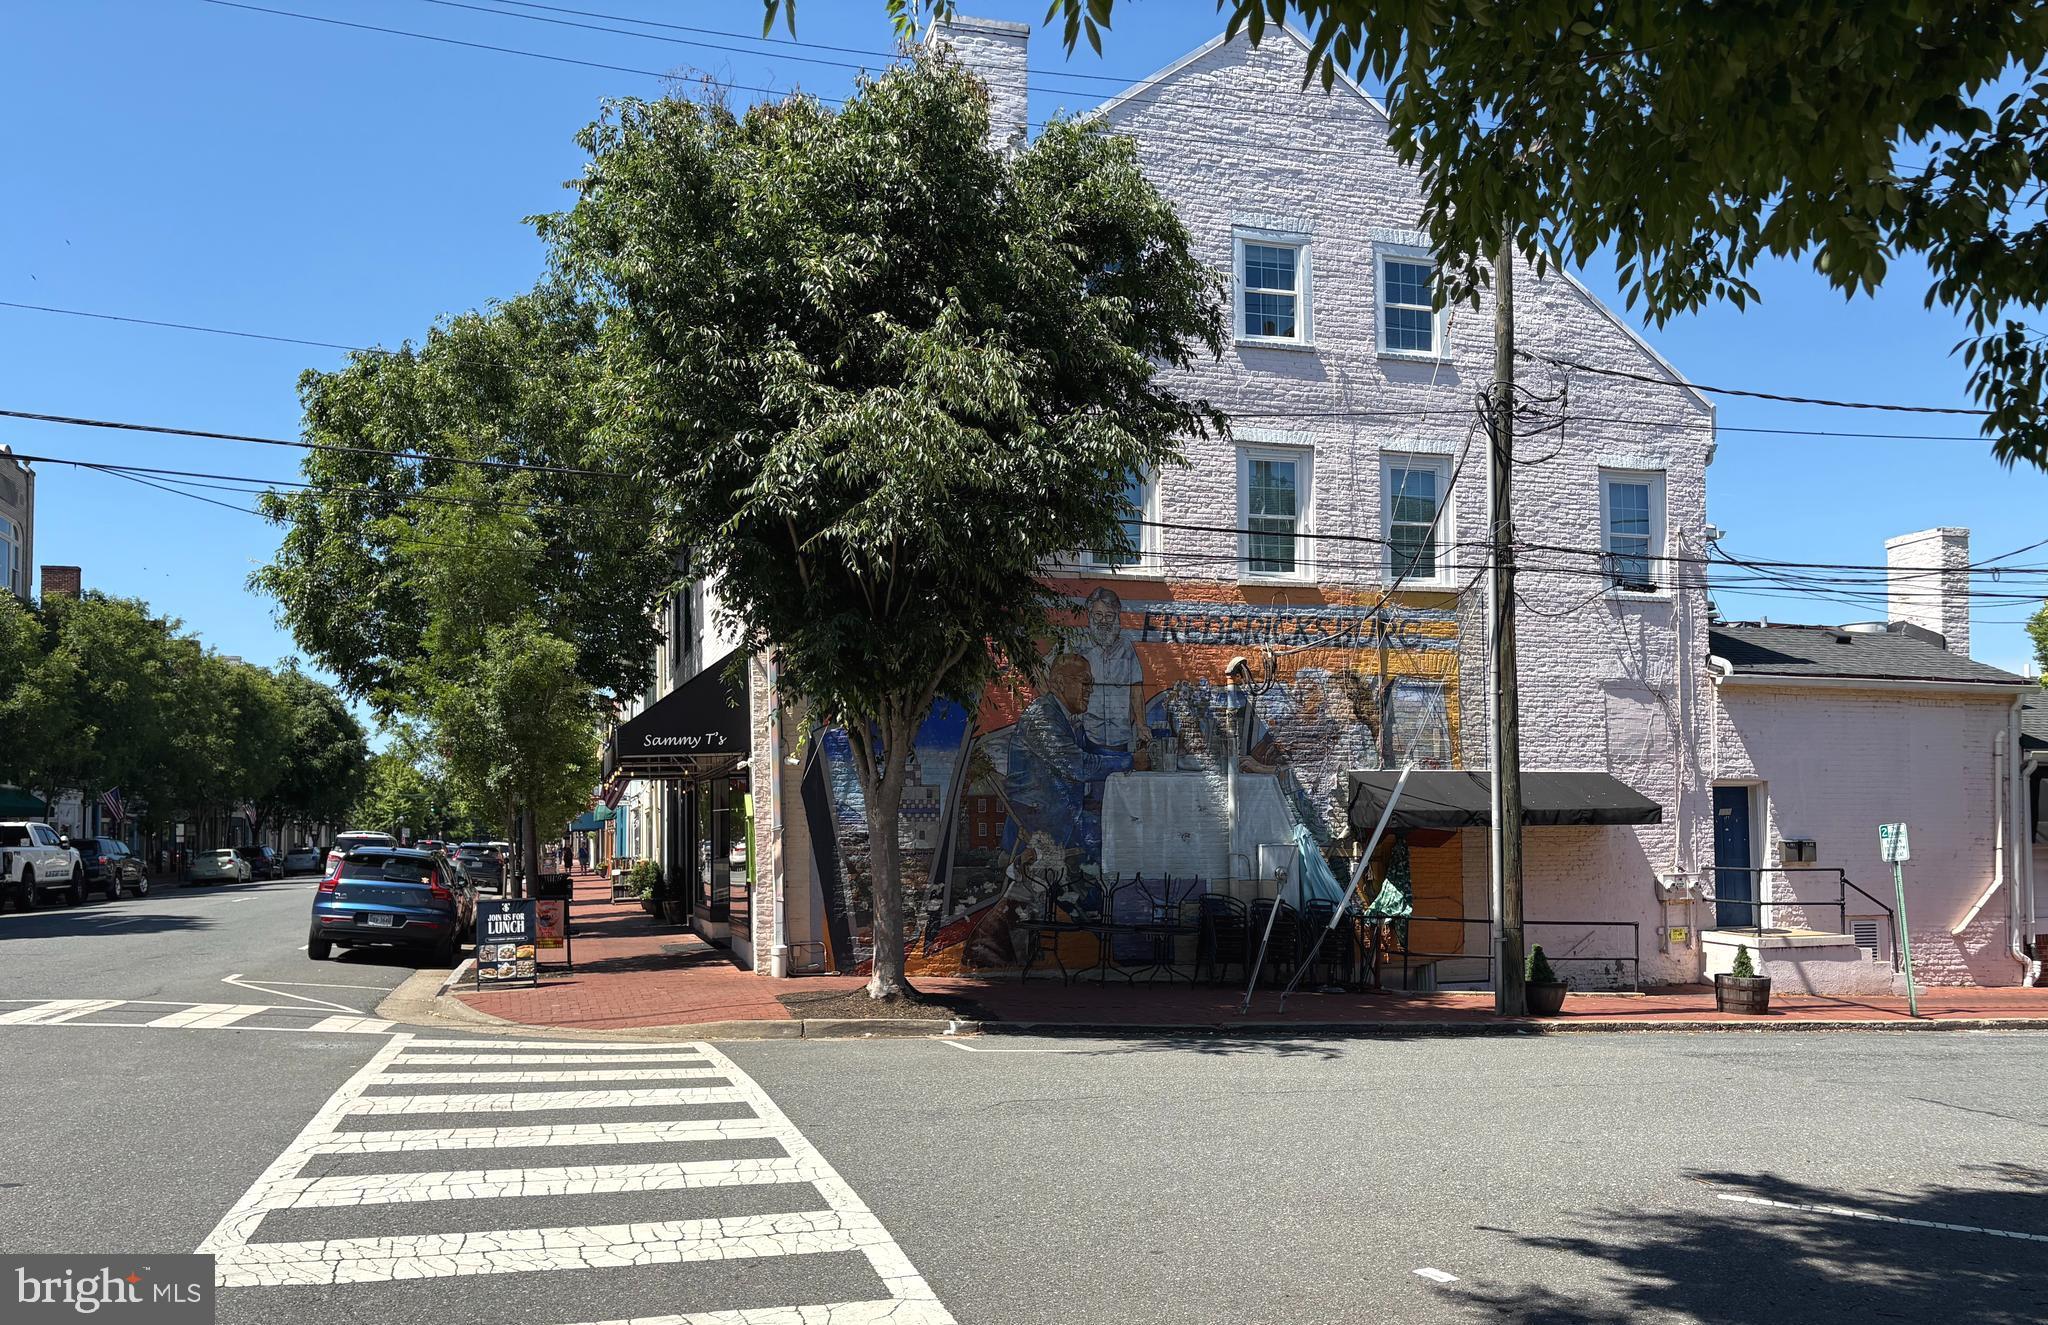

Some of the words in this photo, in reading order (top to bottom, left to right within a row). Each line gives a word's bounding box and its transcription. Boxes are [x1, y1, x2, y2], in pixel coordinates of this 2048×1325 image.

[643, 734, 701, 748] Sammy
[705, 731, 728, 746] T's
[1881, 827, 1888, 838] 2
[487, 914, 502, 922] JOIN
[503, 913, 512, 921] US
[512, 912, 525, 920] FOR
[487, 920, 525, 935] LUNCH
